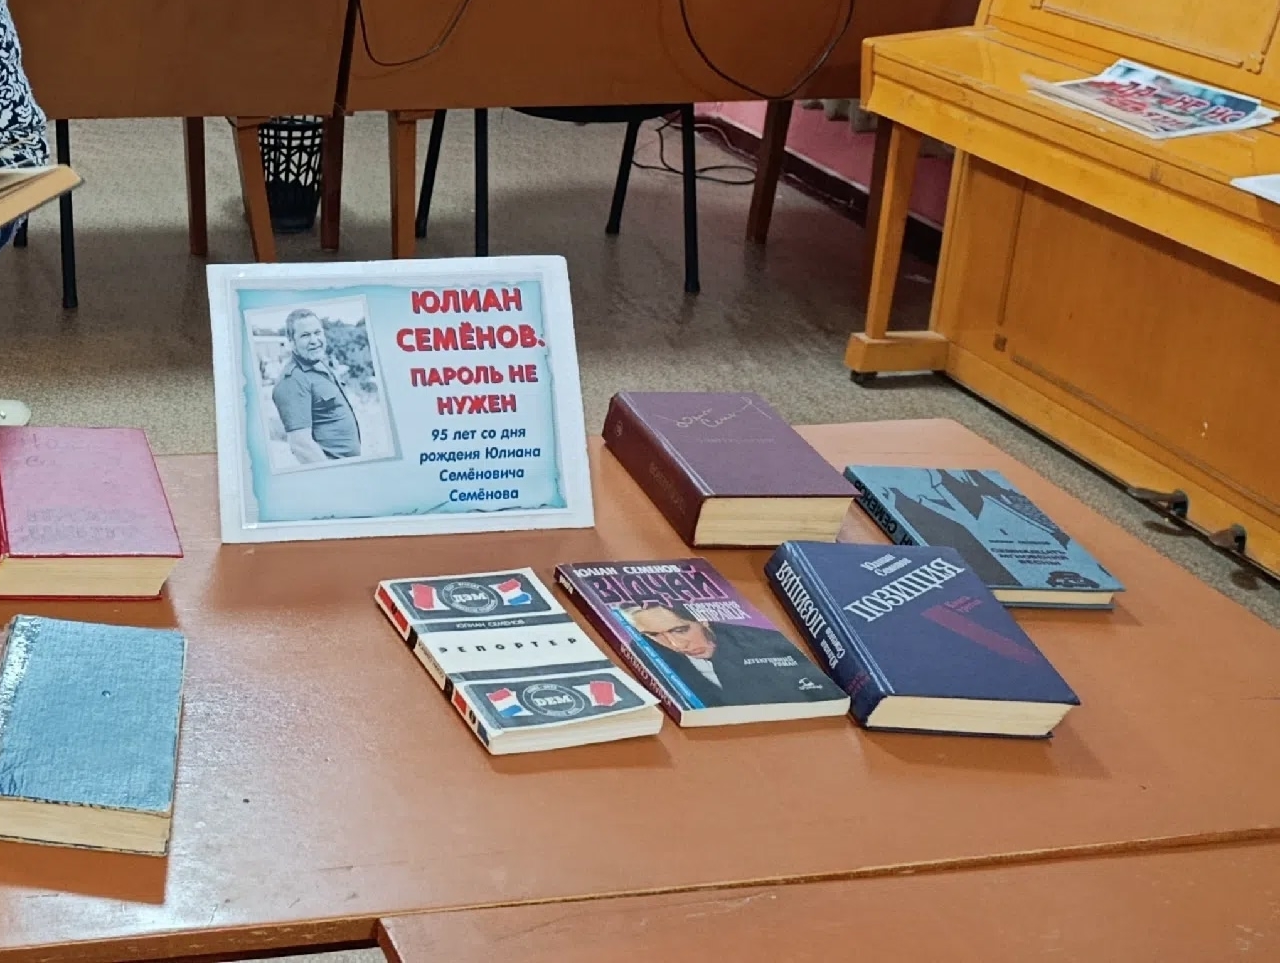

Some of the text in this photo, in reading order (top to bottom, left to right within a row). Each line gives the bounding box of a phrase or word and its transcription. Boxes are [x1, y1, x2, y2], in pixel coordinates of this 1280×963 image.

[410, 287, 523, 315] ЮЛИАН
[396, 321, 546, 353] СЕМЁНОВ.
[410, 364, 539, 387] ПАРОЛЬ НЕ
[436, 394, 517, 415] НУЖЕН
[431, 427, 526, 441] 95 лет со дня
[485, 446, 541, 460] Юлиана
[439, 467, 525, 482] Семёновича
[448, 488, 519, 502] Семёнова
[452, 591, 488, 603] ДЭМ
[842, 557, 966, 623] ПОЗИЦИЯ
[775, 559, 827, 639] ПОЗИЦИЯ
[438, 637, 577, 654] РЕПОРТЕР
[533, 694, 573, 706] DEM
